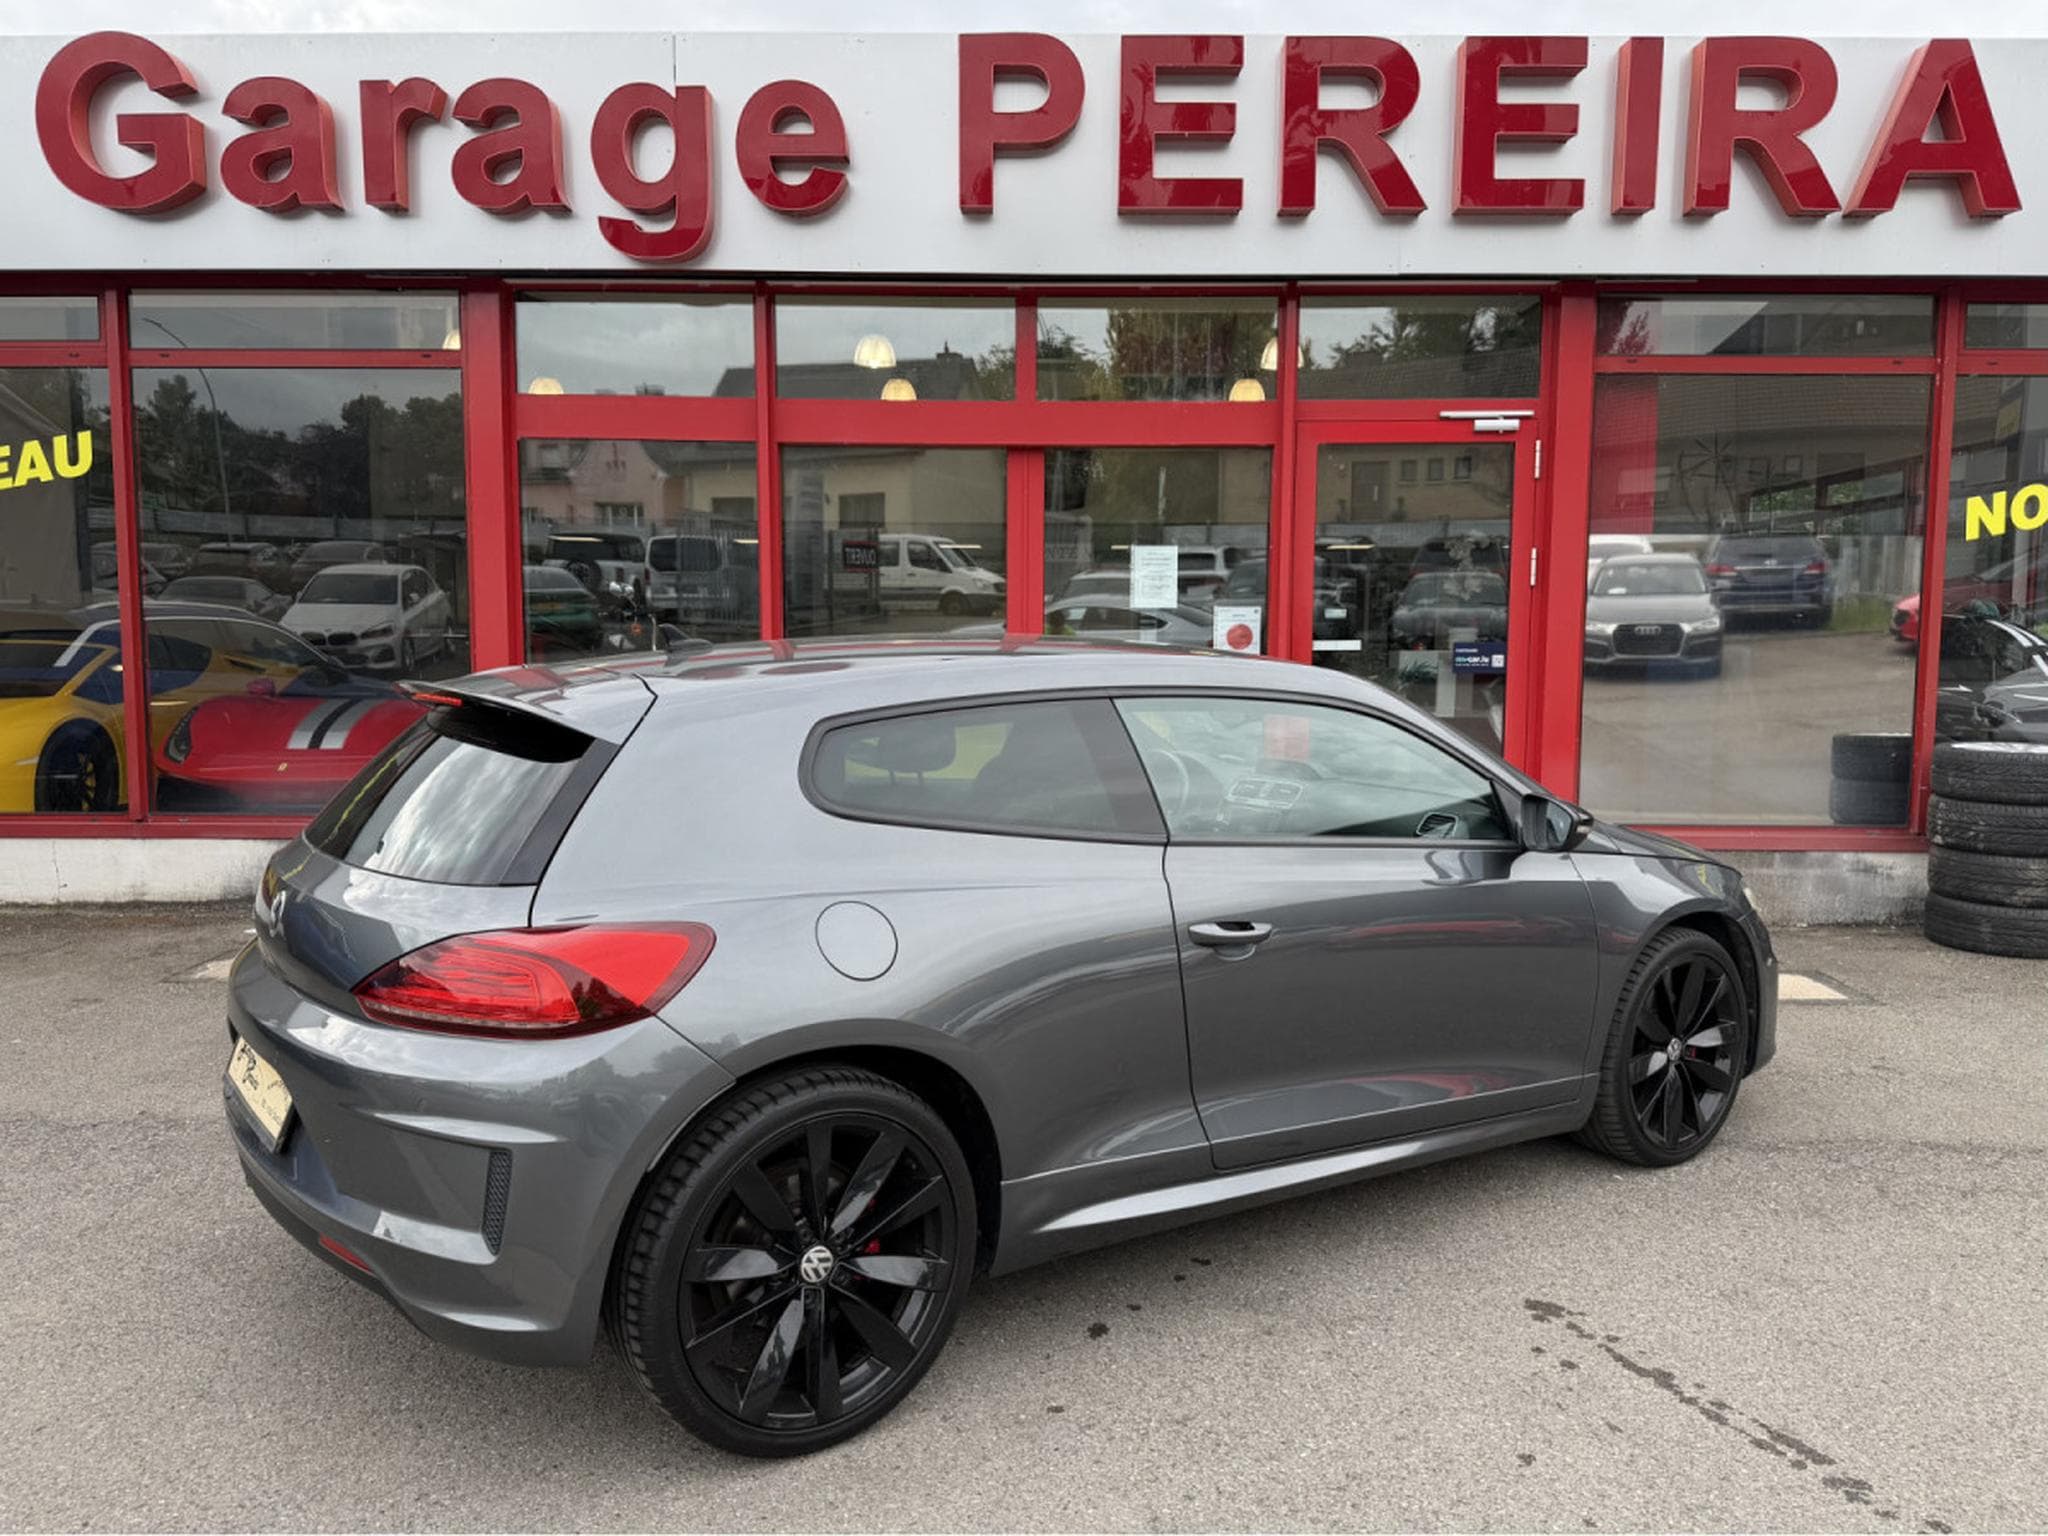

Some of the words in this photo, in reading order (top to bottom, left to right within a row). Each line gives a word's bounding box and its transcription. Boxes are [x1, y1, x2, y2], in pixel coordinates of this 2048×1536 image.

[36, 31, 849, 263] Garage
[958, 33, 2022, 217] PEREIRA
[1965, 484, 2048, 541] NO
